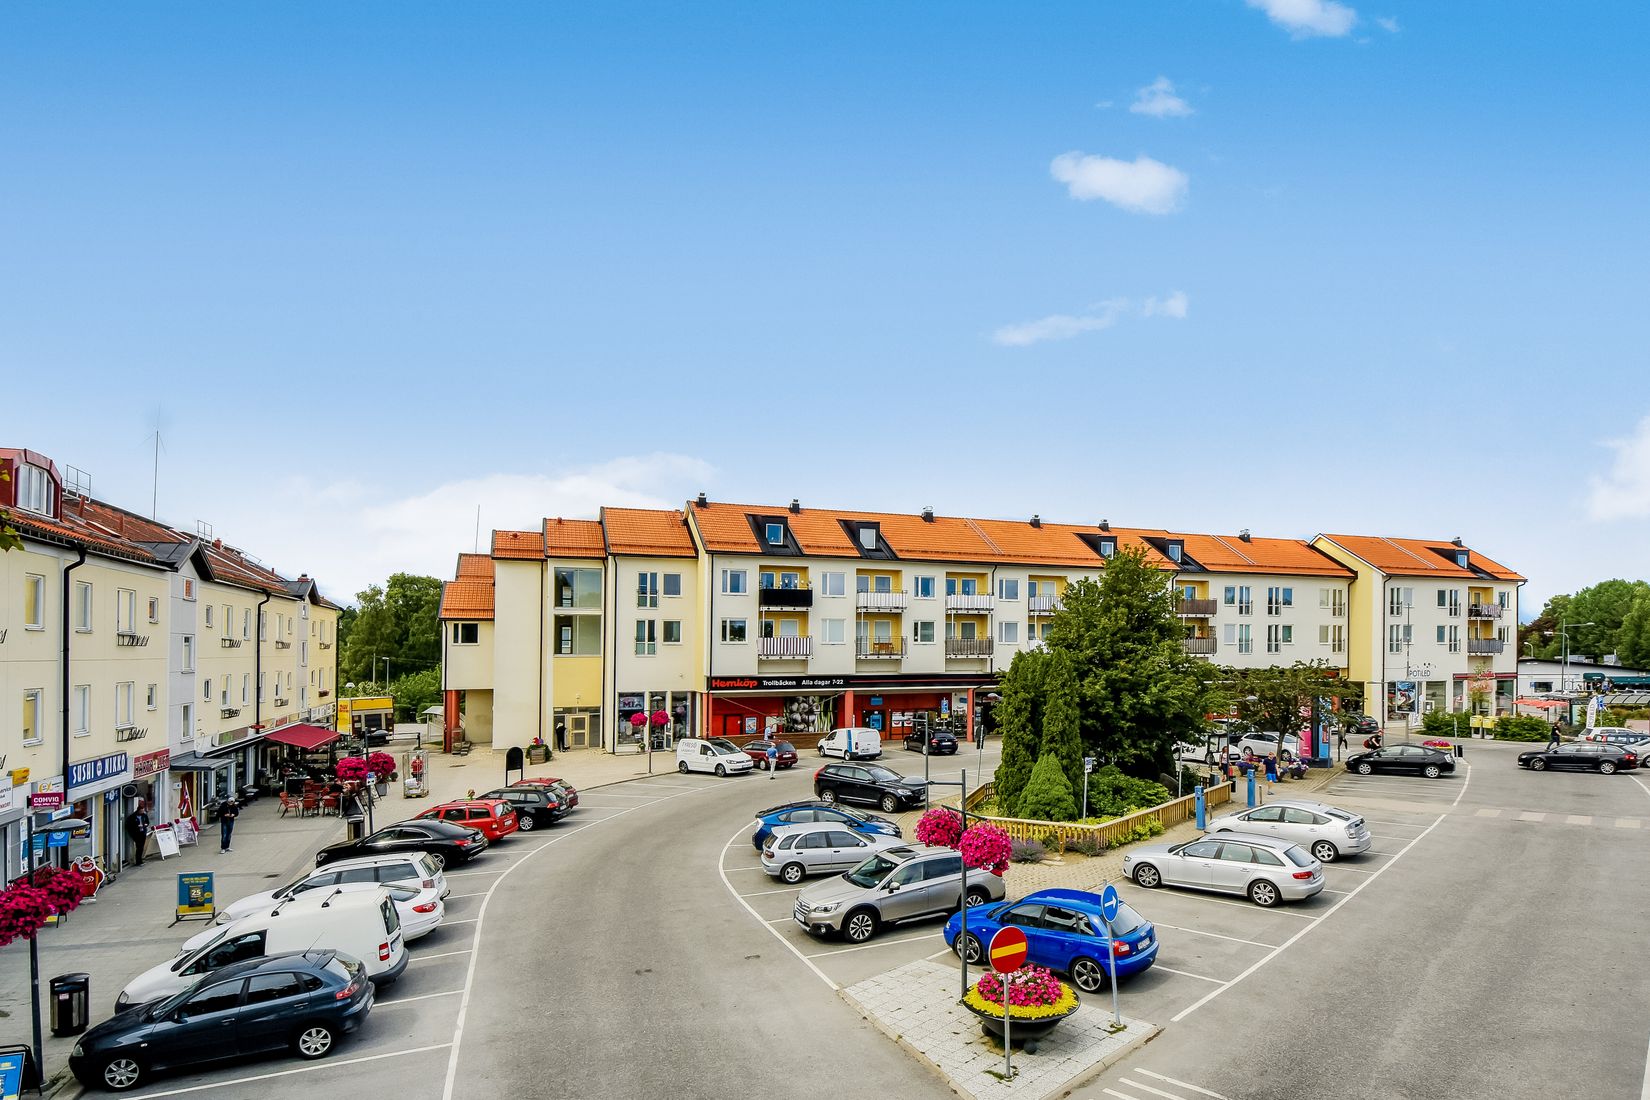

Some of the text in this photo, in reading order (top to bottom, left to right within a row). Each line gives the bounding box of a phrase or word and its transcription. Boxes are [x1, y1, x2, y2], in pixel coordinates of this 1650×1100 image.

[712, 678, 758, 688] Hemköp
[72, 754, 126, 784] SUSHI NIKKO
